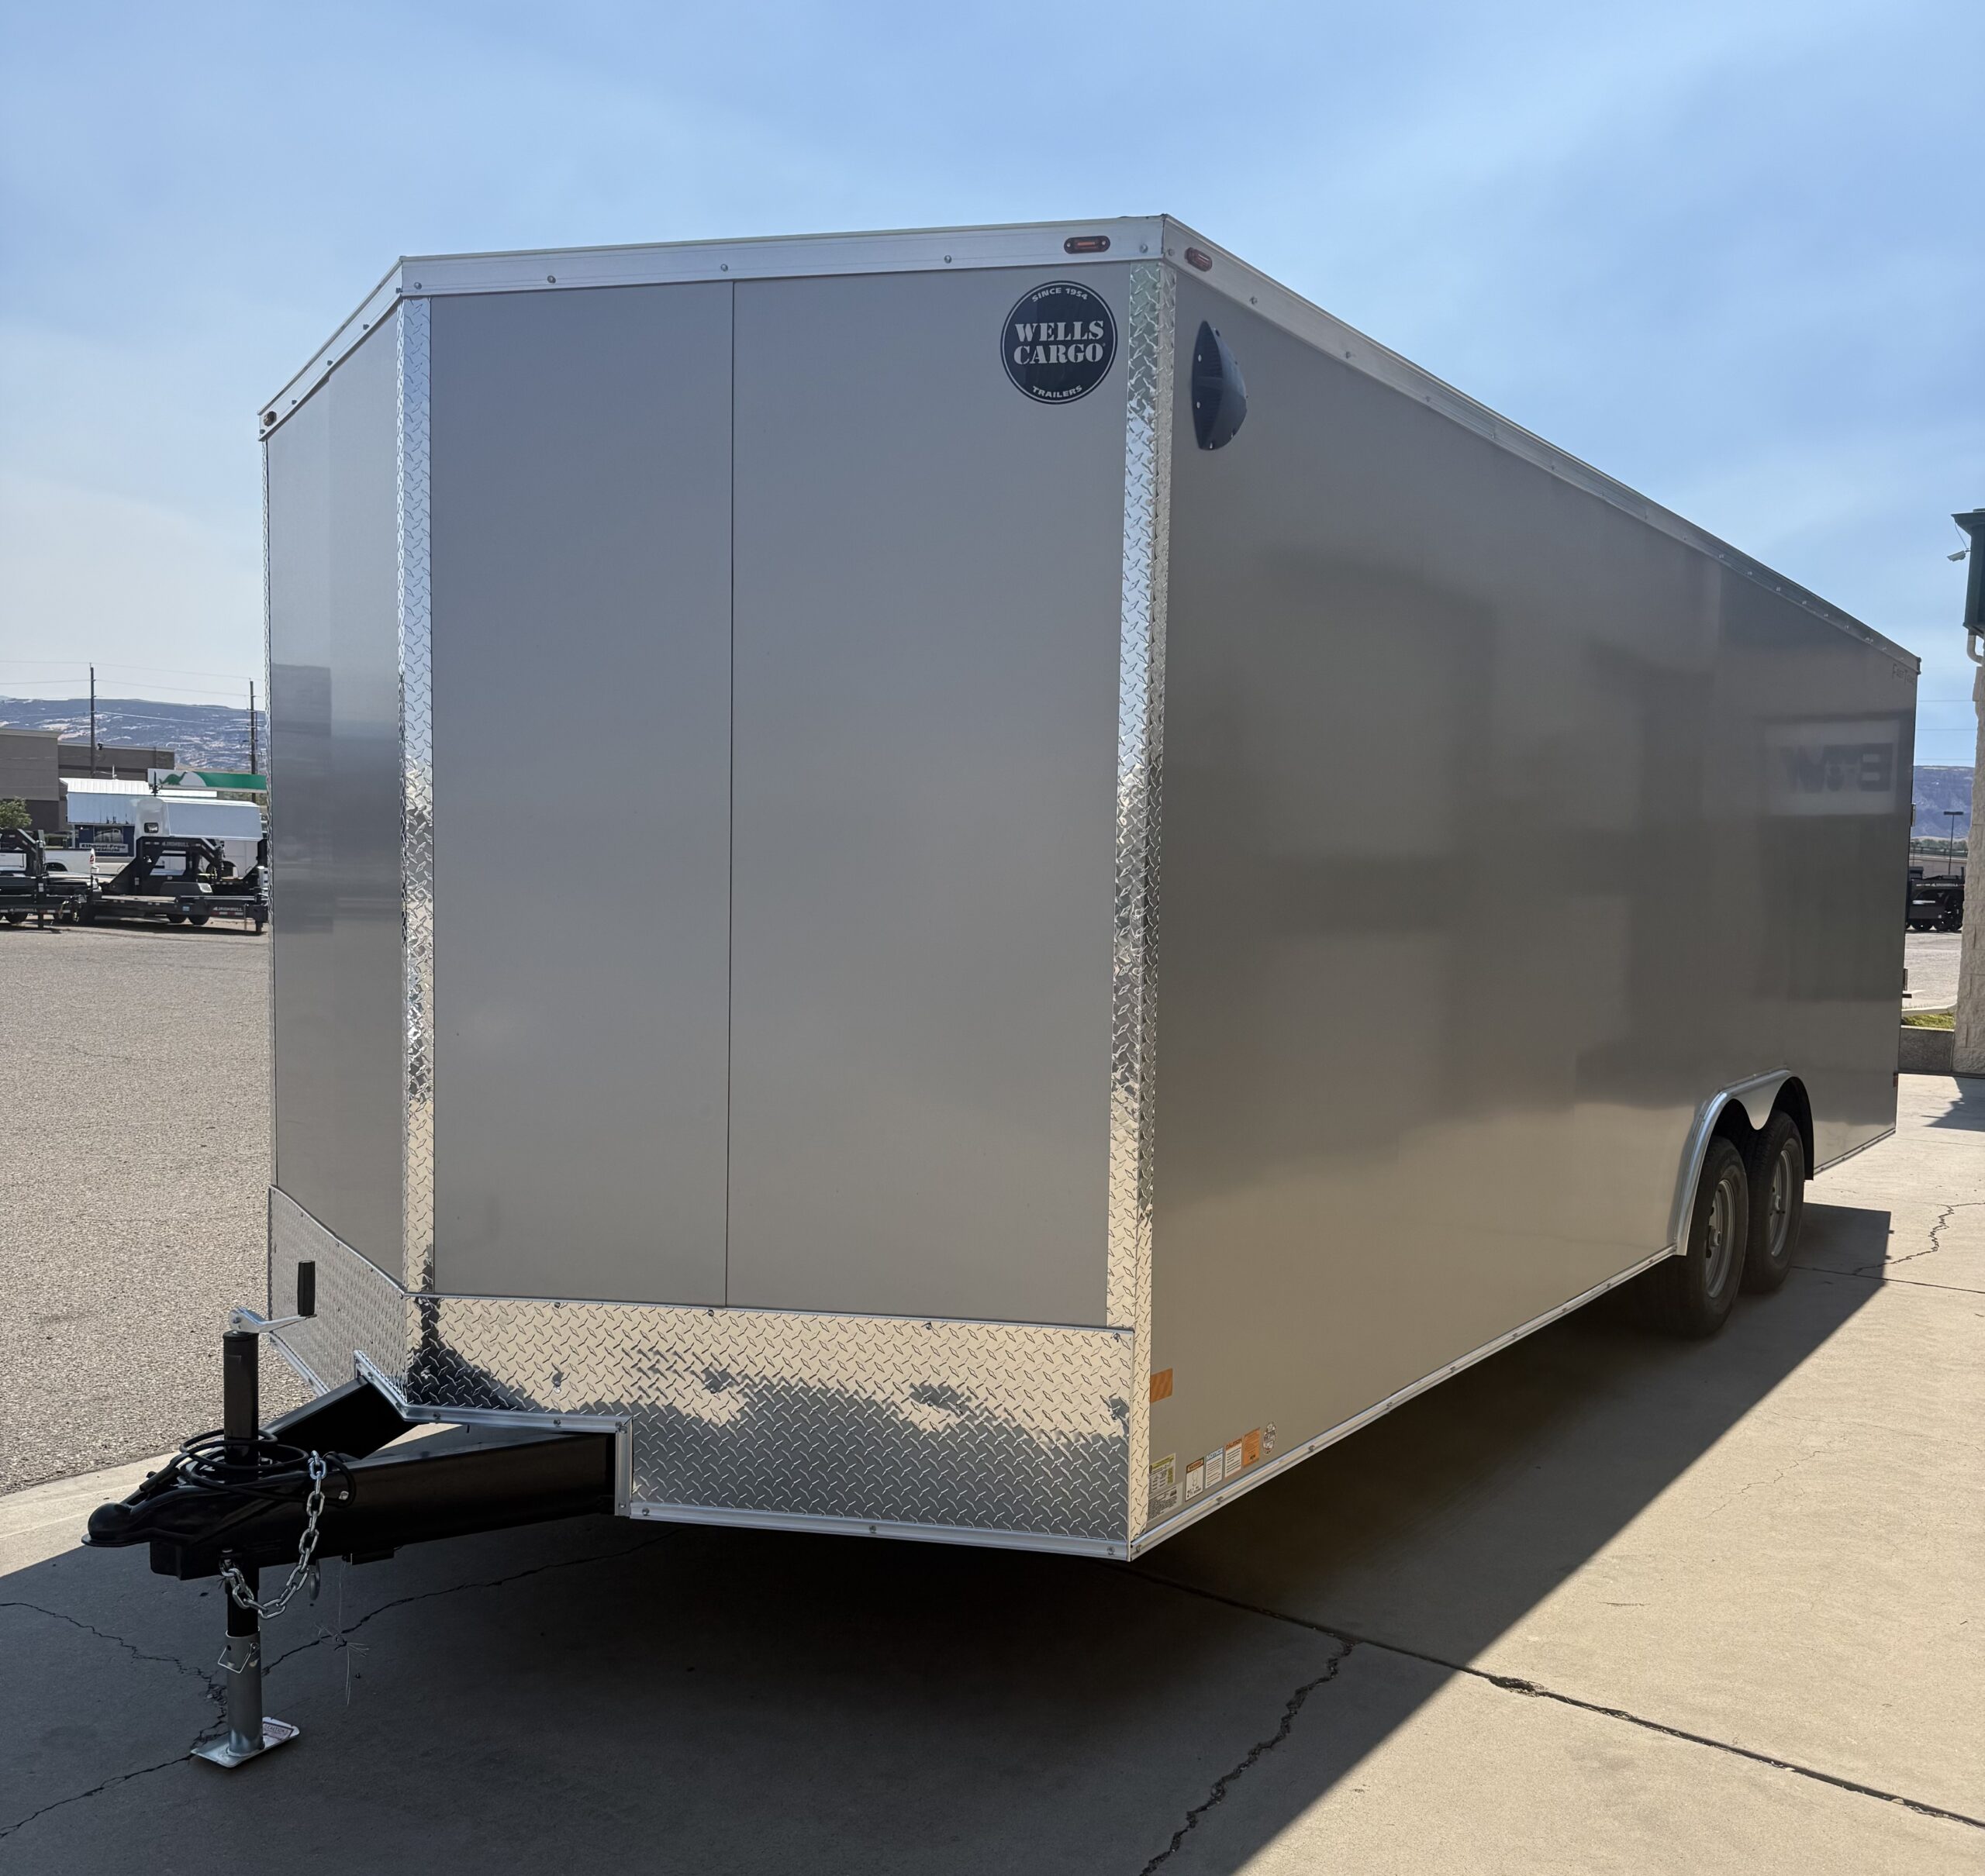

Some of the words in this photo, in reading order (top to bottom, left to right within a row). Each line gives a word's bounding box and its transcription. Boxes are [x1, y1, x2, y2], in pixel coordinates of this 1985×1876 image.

[1032, 288, 1062, 302] SINCE
[1065, 288, 1088, 300] 1954
[1014, 320, 1104, 342] WELLS
[1013, 343, 1103, 364] CARGO
[1033, 385, 1082, 398] TRAILERS
